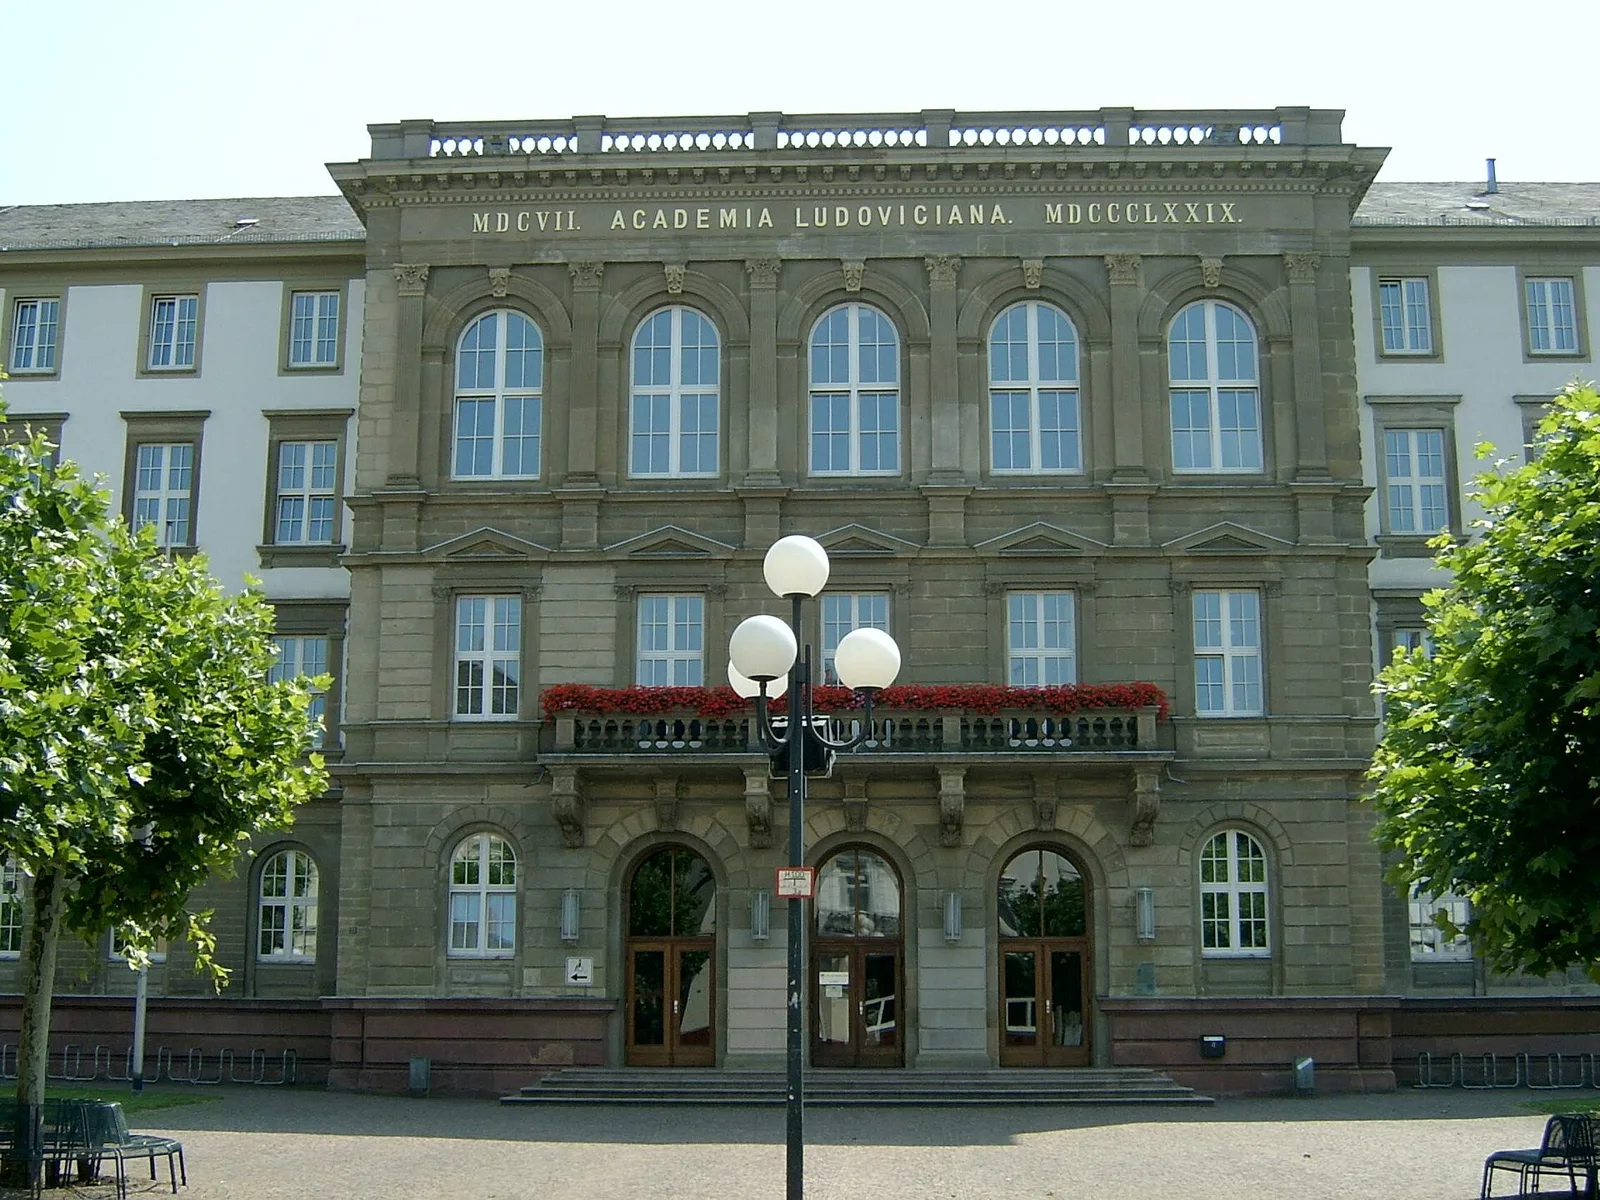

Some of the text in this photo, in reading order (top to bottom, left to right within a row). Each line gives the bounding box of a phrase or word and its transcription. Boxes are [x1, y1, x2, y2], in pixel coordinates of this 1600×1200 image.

[472, 202, 1244, 233] MDCVII. ACADEMIA LUDOVICIANA. MDCCCLXXIX.
